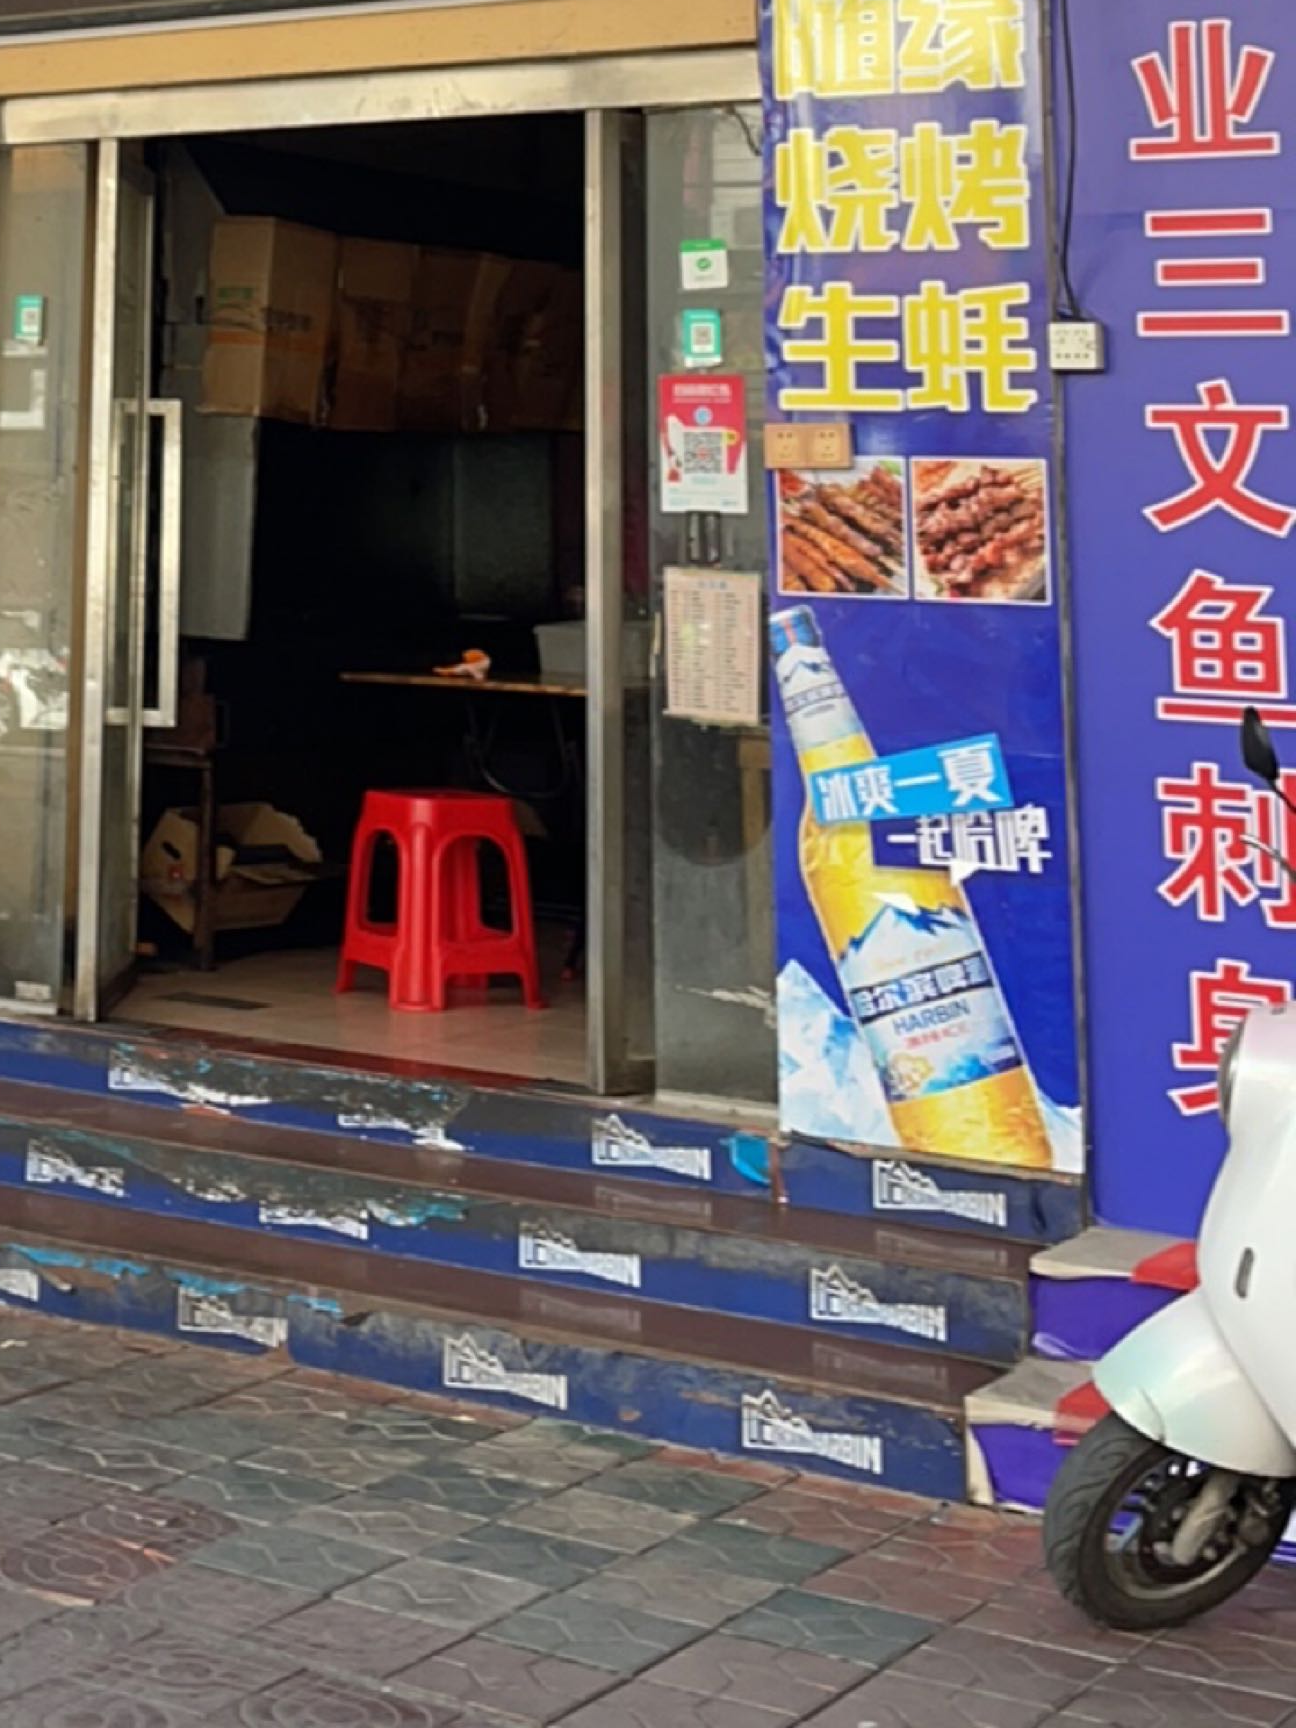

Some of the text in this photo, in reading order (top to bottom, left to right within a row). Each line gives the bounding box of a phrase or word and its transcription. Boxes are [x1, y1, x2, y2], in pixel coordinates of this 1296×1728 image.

[776, 119, 1030, 254] 烧烤
[777, 280, 1038, 413] 生蚝
[815, 741, 1005, 821] 冰爽一夏
[891, 999, 971, 1036] HARBIN
